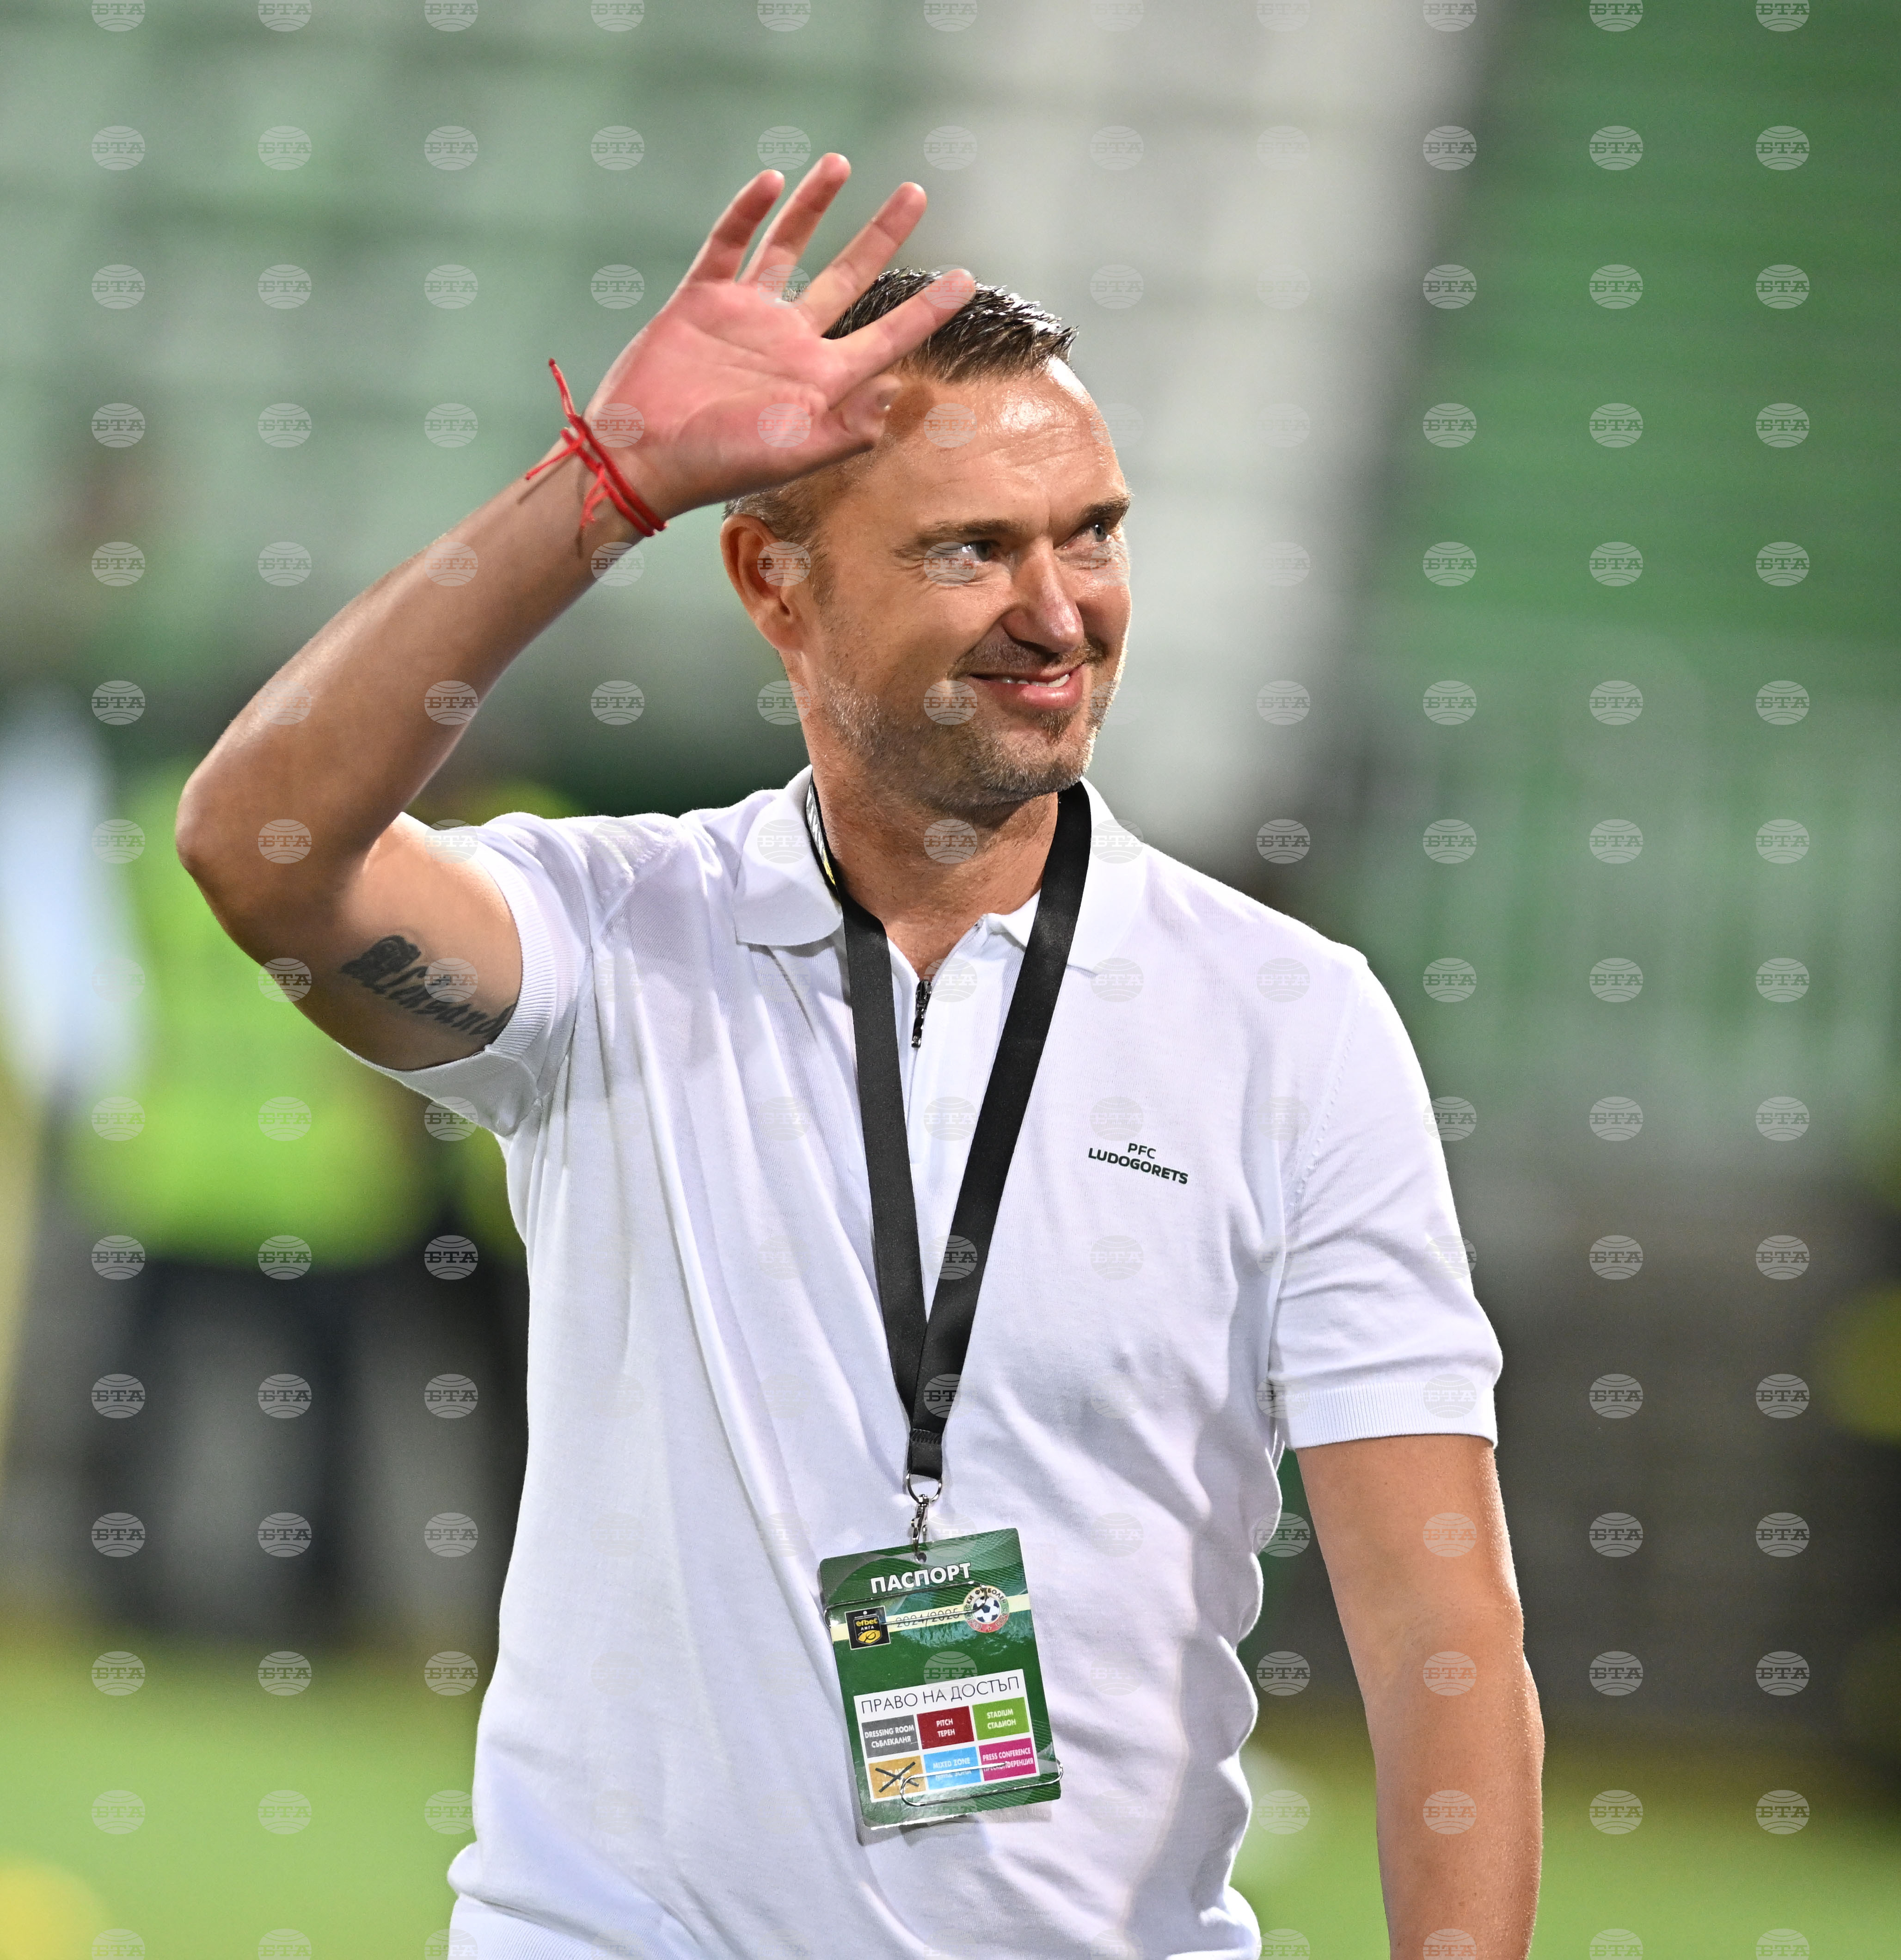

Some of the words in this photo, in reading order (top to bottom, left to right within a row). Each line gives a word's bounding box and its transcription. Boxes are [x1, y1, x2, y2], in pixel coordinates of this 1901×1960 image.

[1128, 1143, 1156, 1159] PFC
[1088, 1147, 1188, 1184] LUDOGORETS
[870, 1562, 971, 1593] ПАСПОРТ
[855, 1617, 878, 1627] efbet
[895, 1608, 960, 1628] 2024/2025
[861, 1693, 918, 1714] ПРАВО
[923, 1689, 947, 1704] НА
[950, 1676, 1020, 1702] ДОСТЪП
[987, 1709, 1014, 1719] STADIUM
[987, 1719, 1016, 1730] СТАДИОН
[865, 1727, 894, 1739] DRESSING
[895, 1725, 915, 1733] ROOM
[937, 1728, 956, 1738] ТЕРЕН
[871, 1735, 911, 1748] СЪБЛЕКАЛНЯ
[982, 1753, 998, 1762] PRESS
[999, 1747, 1031, 1759] CONFERENCE
[933, 1760, 952, 1769] MIXED
[953, 1757, 971, 1766] ZONE
